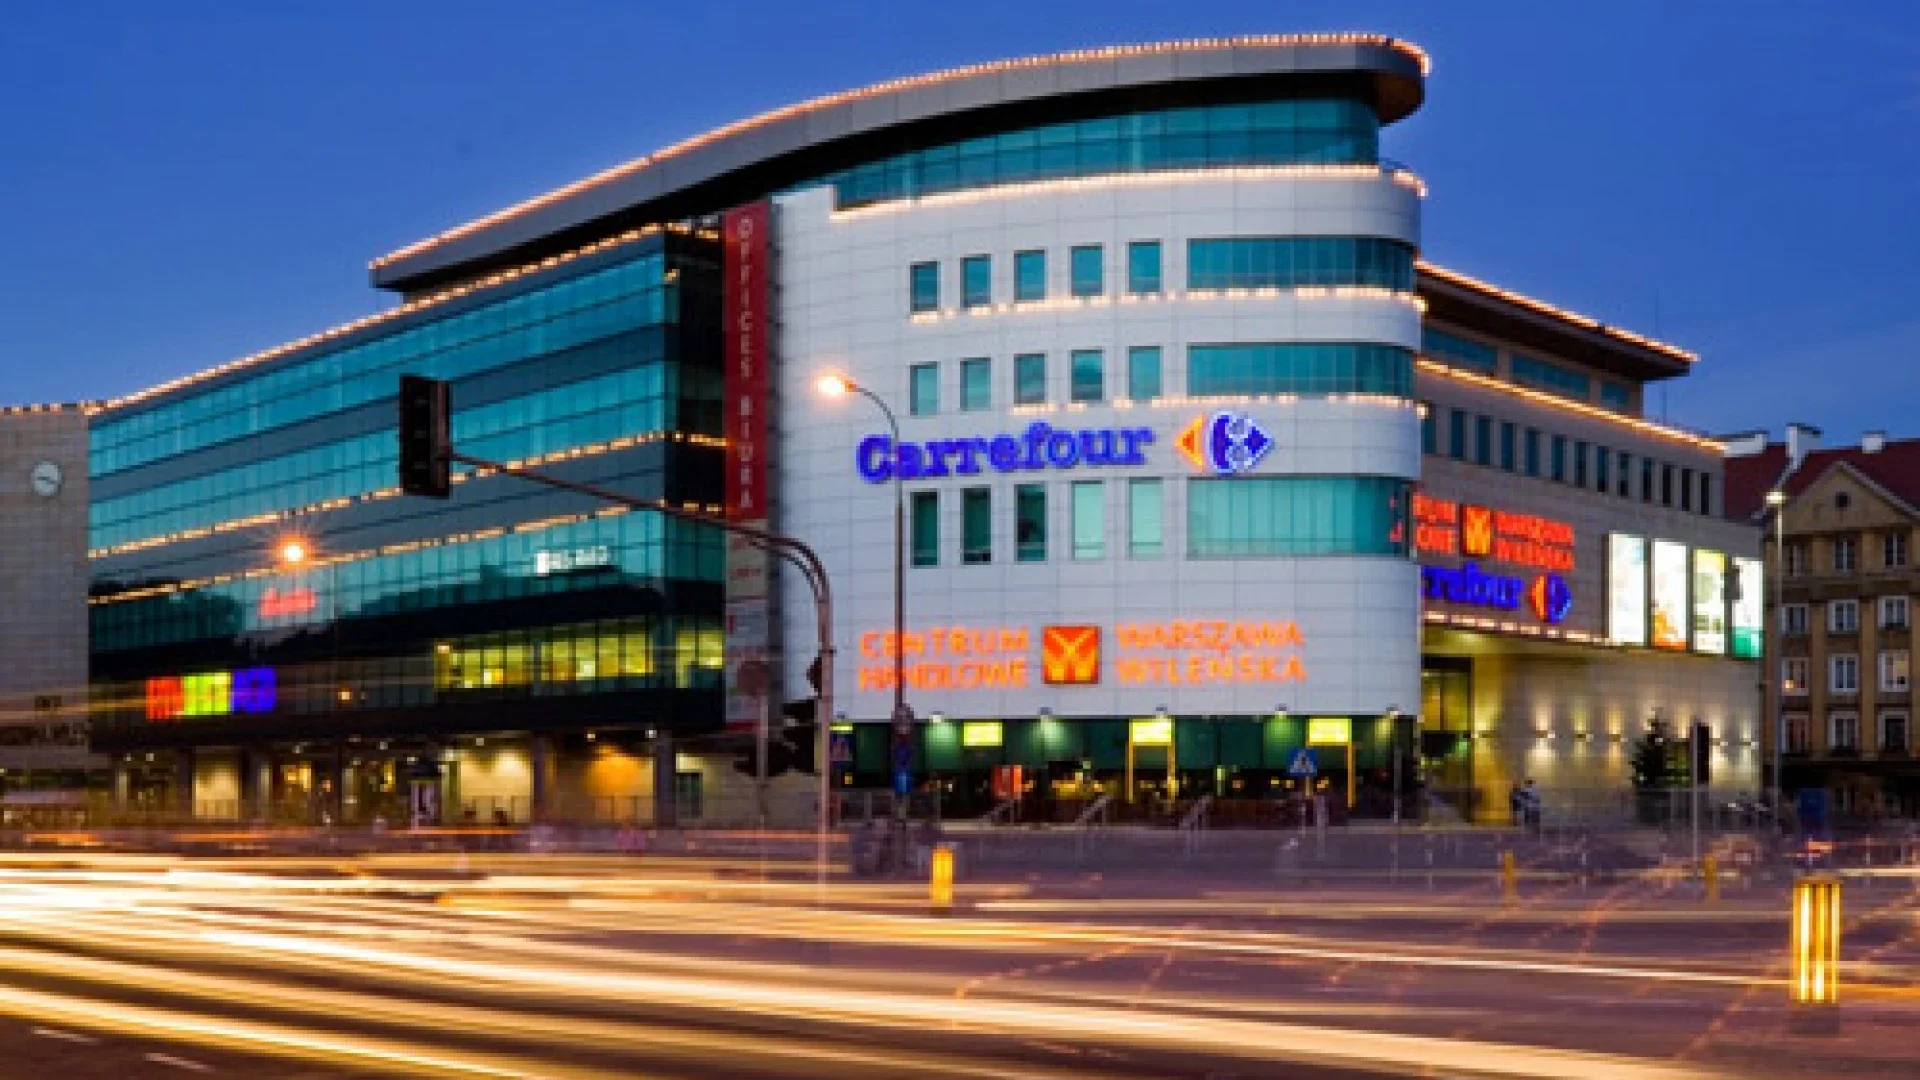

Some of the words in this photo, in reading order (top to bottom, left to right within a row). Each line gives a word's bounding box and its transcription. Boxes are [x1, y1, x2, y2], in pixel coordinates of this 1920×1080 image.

[856, 421, 1156, 484] Carrefour
[859, 624, 1030, 659] CENTRUM
[1114, 618, 1306, 651] WARSZAWA
[859, 656, 1028, 692] HANDLOWE
